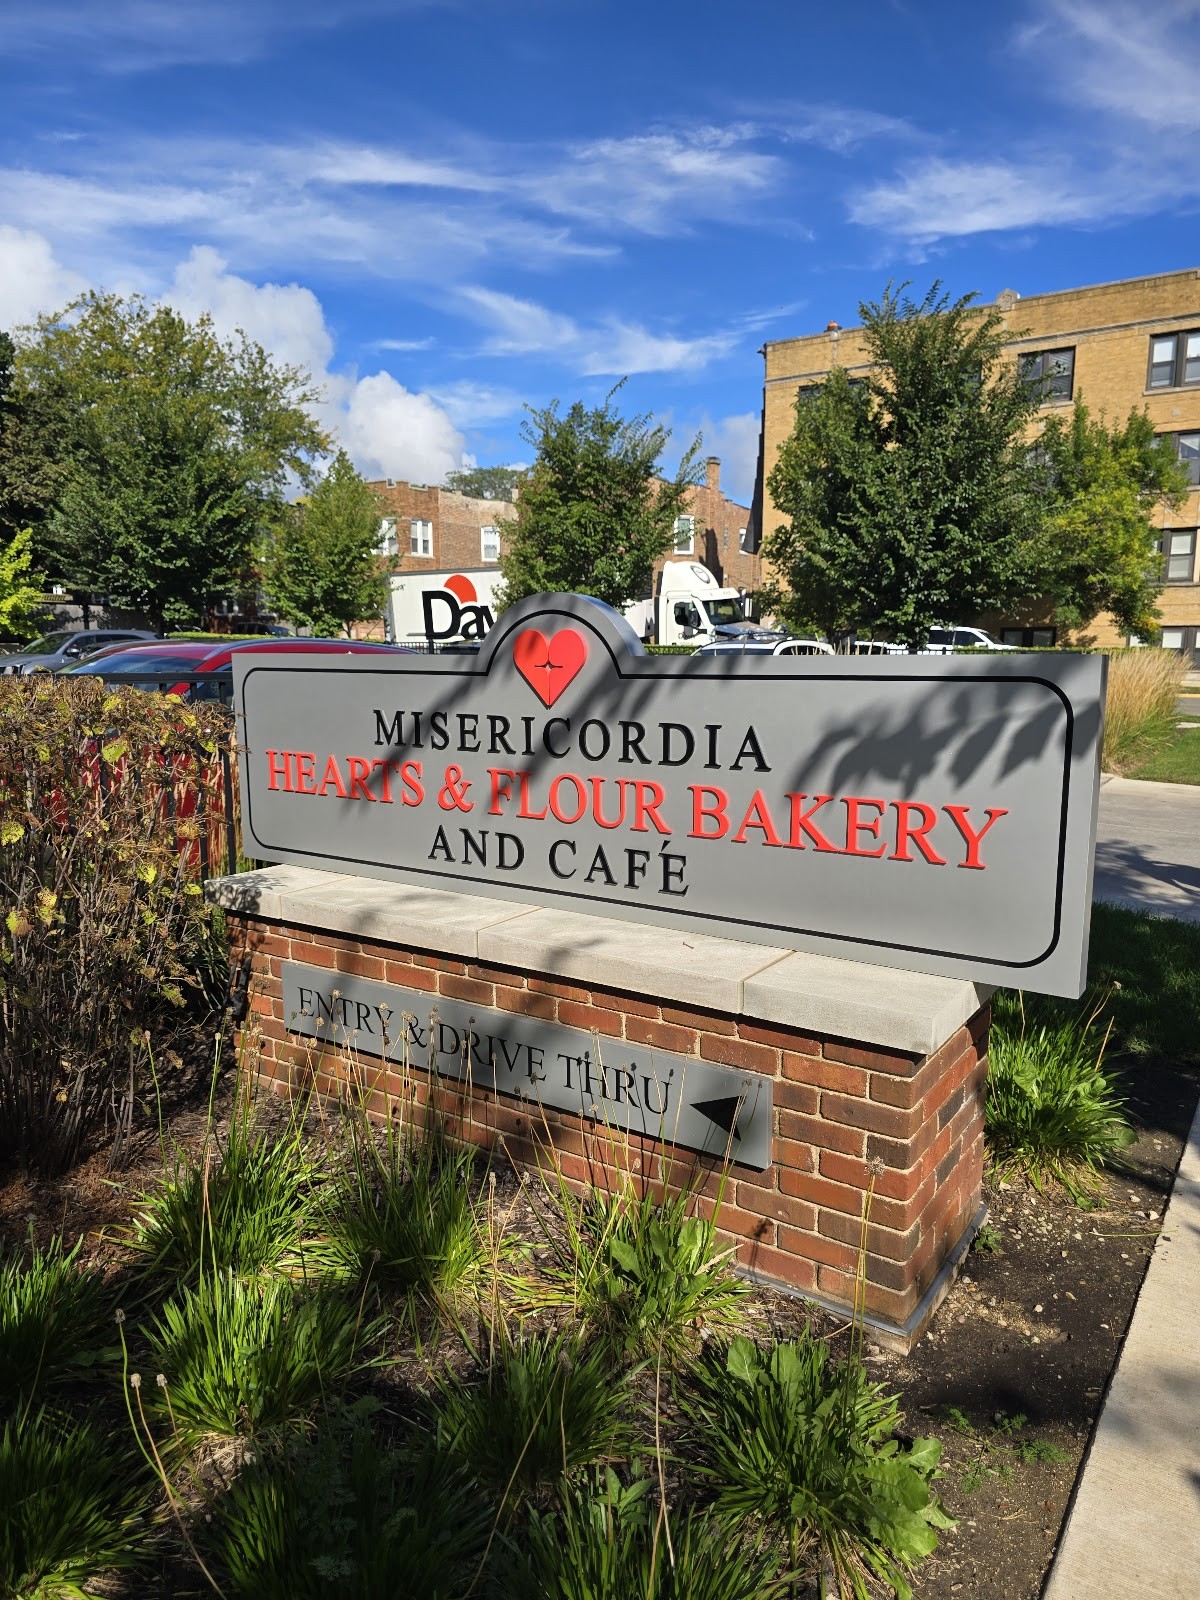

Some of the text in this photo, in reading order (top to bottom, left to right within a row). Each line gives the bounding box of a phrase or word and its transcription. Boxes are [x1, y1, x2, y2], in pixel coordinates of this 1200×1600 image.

[373, 709, 772, 772] MISERICORDIA
[266, 750, 1009, 870] HEARTS & FLOUR BAKERY
[428, 825, 689, 897] AND CAFÉ
[297, 987, 673, 1115] ENTRY & DRIVE THRU
